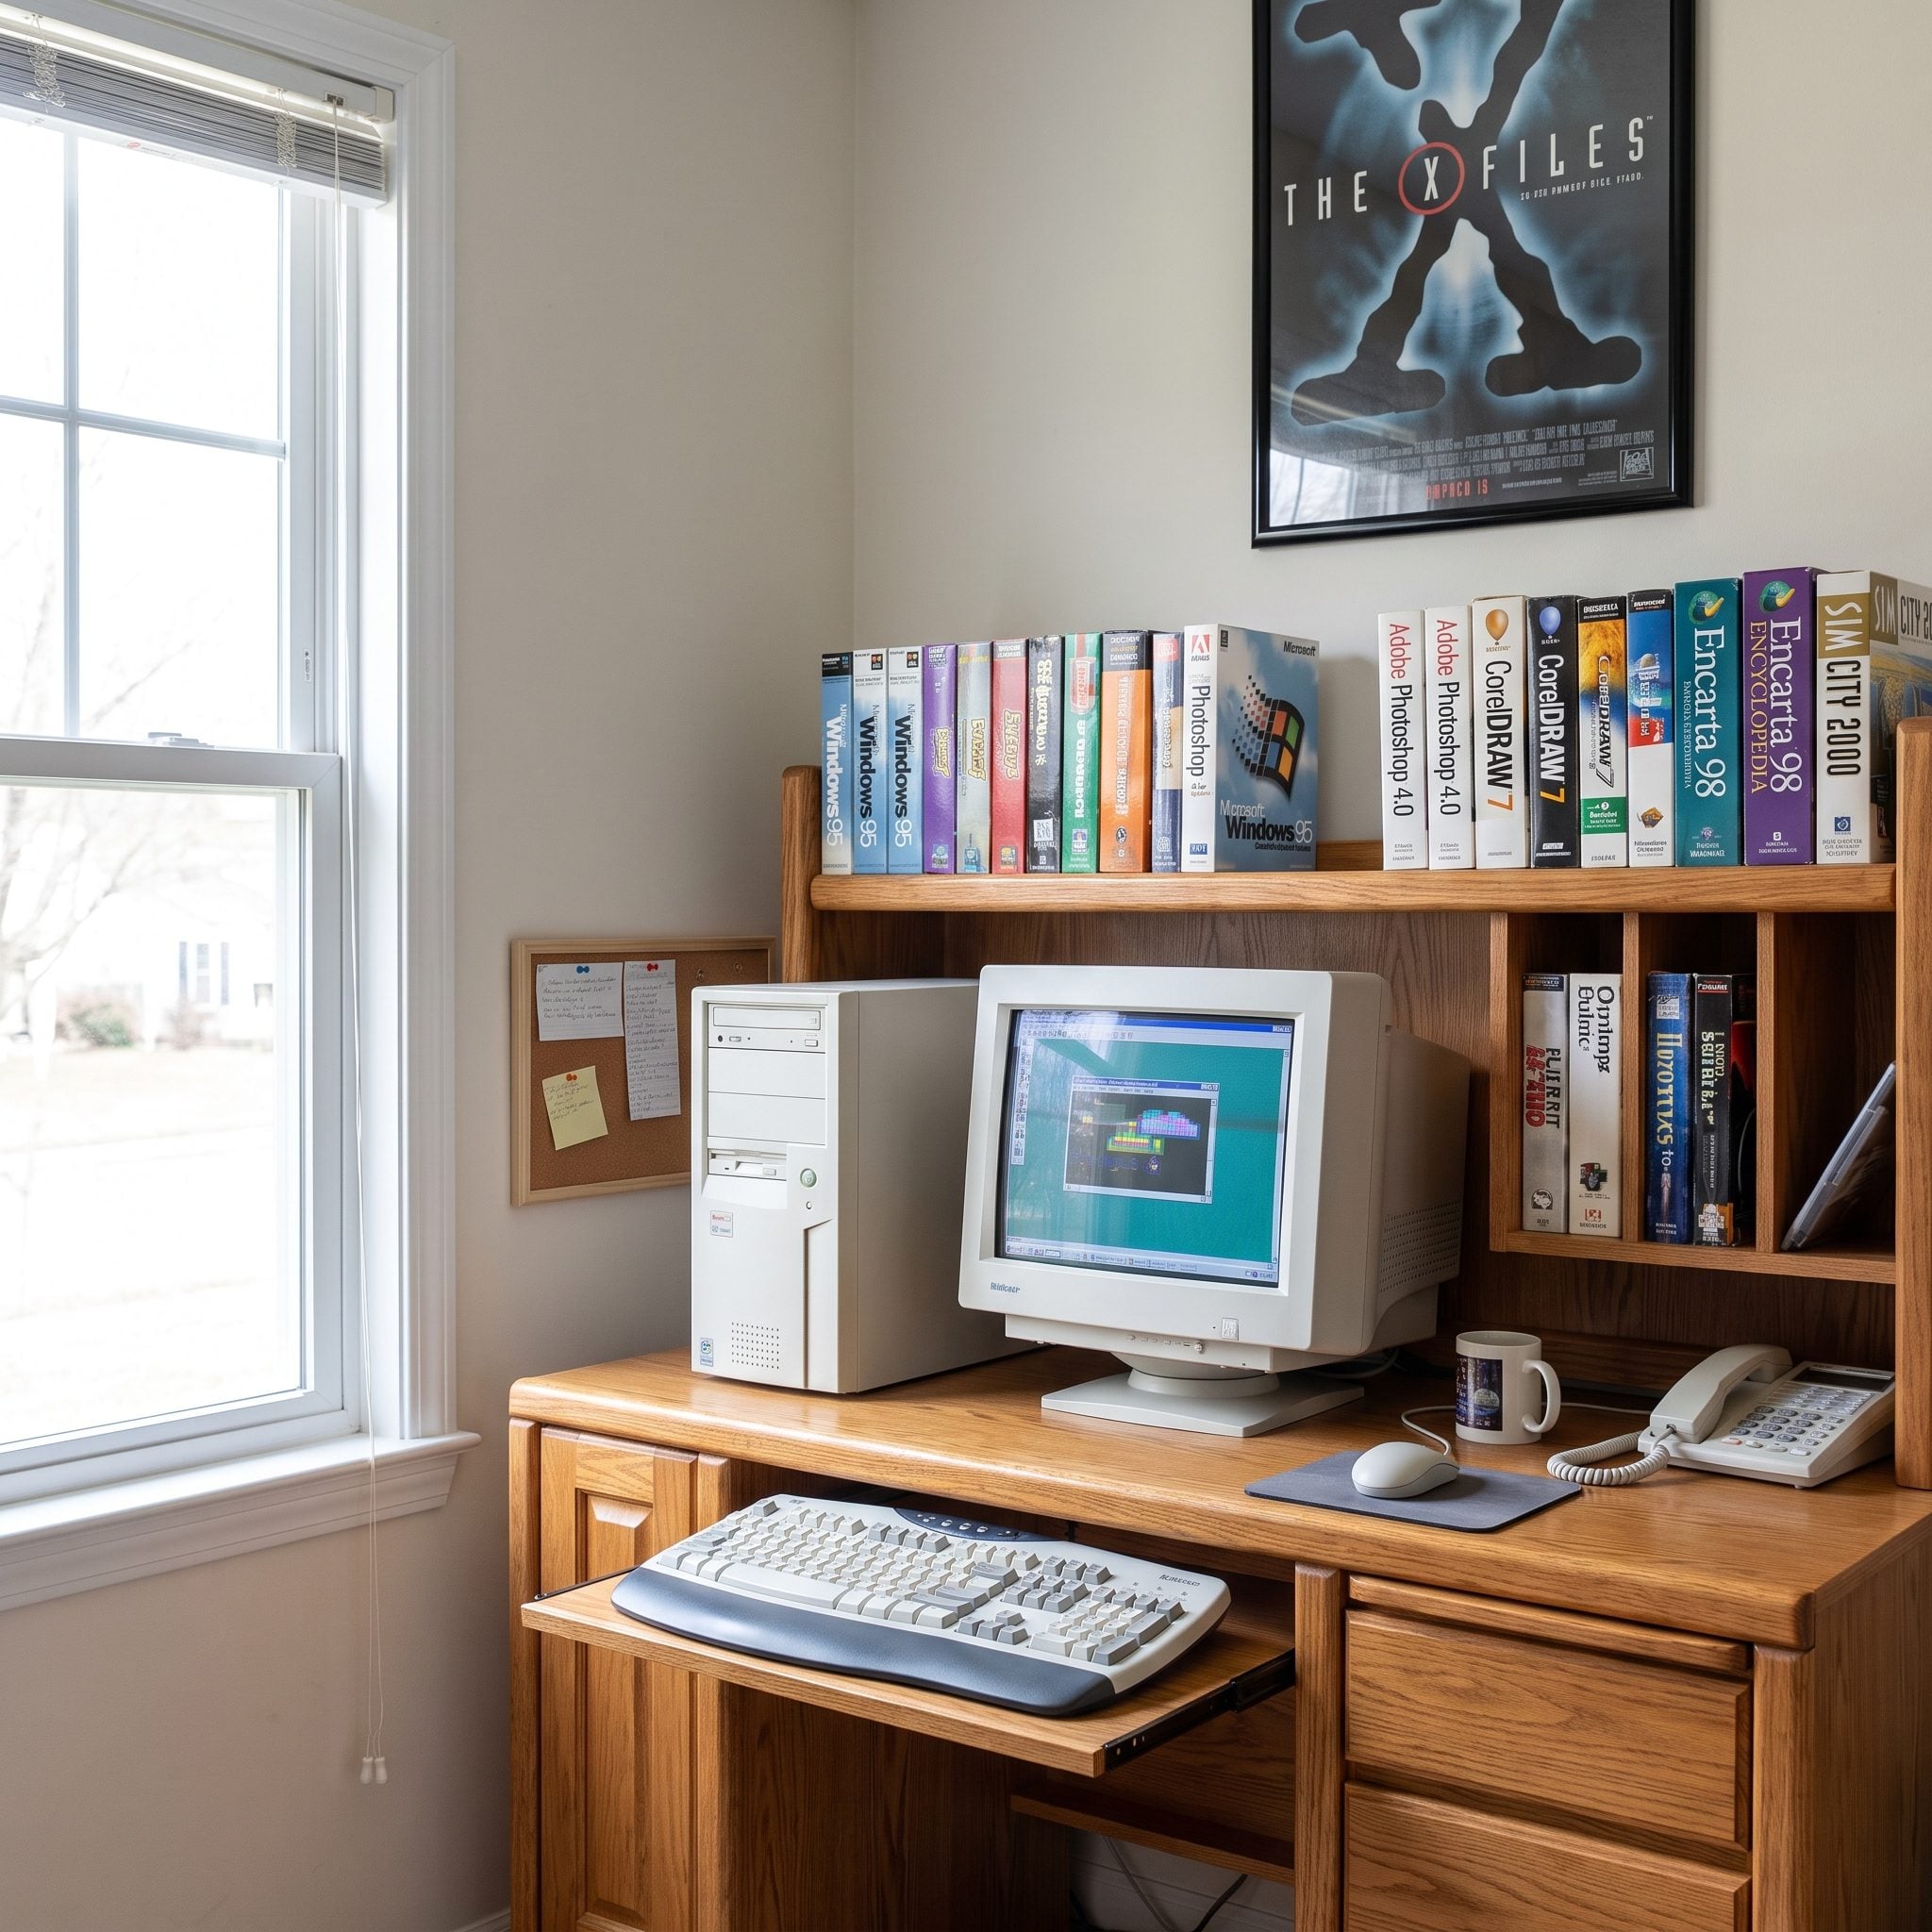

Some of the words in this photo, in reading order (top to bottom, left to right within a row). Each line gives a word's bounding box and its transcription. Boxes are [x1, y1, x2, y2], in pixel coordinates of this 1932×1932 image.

[1284, 170, 1368, 226] THE
[1423, 155, 1440, 202] X
[1482, 117, 1644, 191] FILES
[1824, 602, 1864, 652] SIM
[1874, 584, 1896, 636] SIM
[1900, 594, 1921, 638] CITY
[1389, 623, 1410, 679] Adobe
[1436, 619, 1459, 676] Adobe
[1694, 626, 1725, 755] Encarta
[1750, 621, 1769, 794] ENCYCLOPEDIA
[1770, 616, 1802, 747] Encarta
[1826, 659, 1861, 709] CITY
[1186, 686, 1211, 777] Photoshop
[1387, 684, 1413, 783] Photoshop
[1433, 681, 1461, 782] Photoshop
[1485, 659, 1513, 790] CorelDRAW
[1538, 654, 1565, 783] CorelDRAW
[1826, 718, 1861, 776] 2000
[1440, 786, 1461, 816] 4.0
[1487, 790, 1513, 811] 7
[1540, 787, 1565, 804] 7
[1694, 758, 1726, 798] 98
[1770, 754, 1803, 793] 98
[1392, 787, 1414, 818] 4.0
